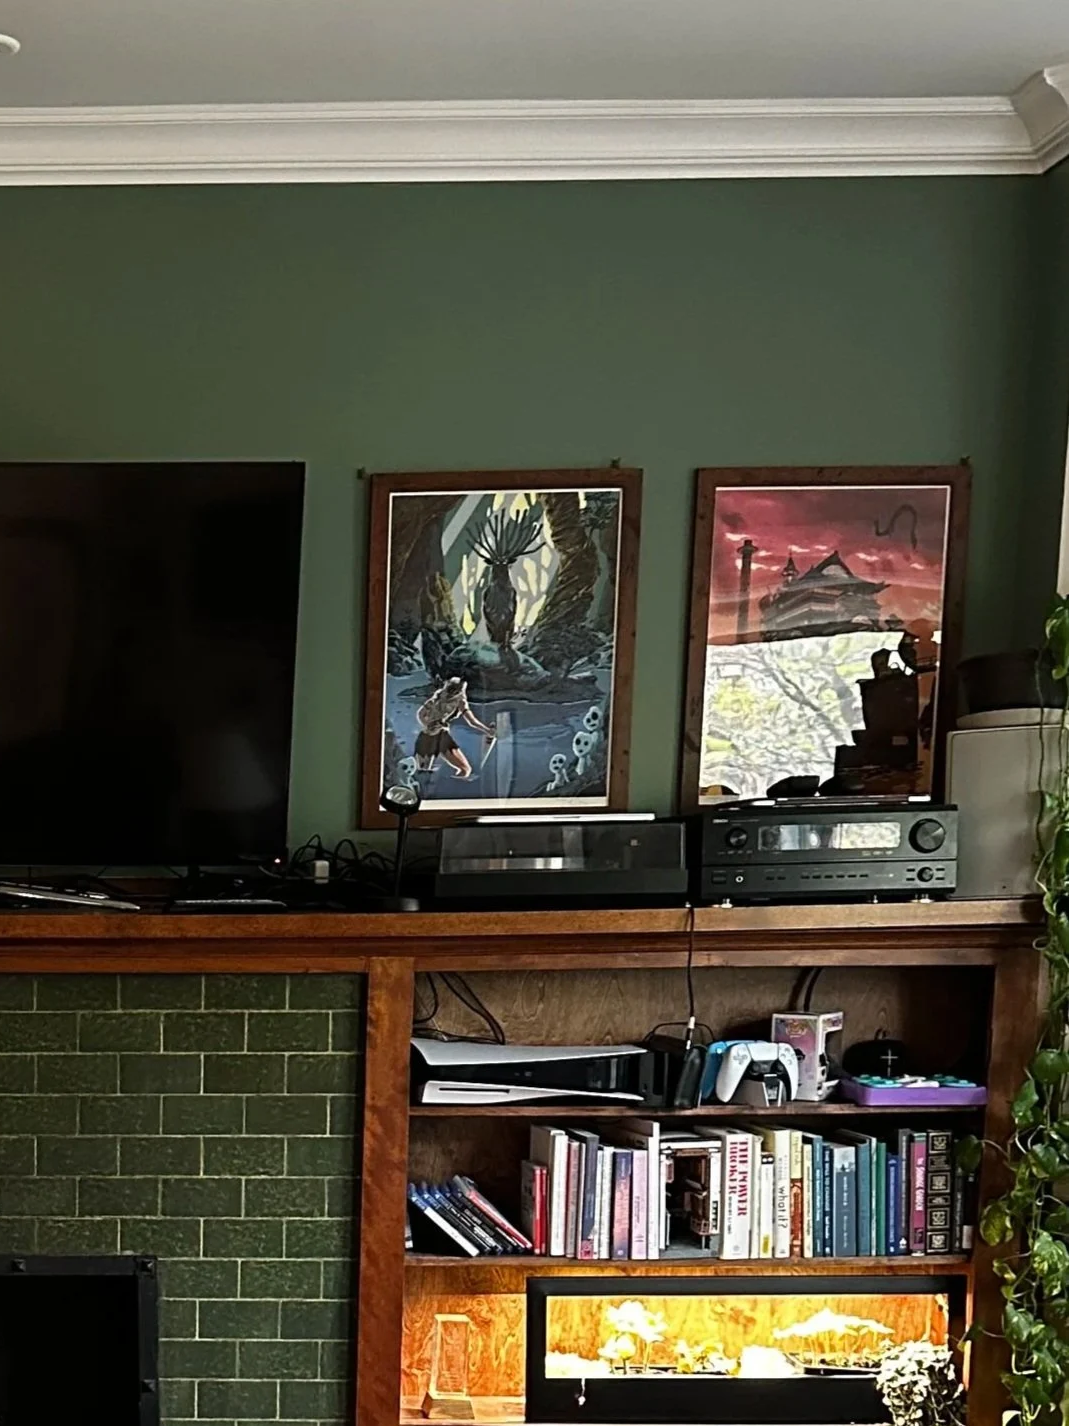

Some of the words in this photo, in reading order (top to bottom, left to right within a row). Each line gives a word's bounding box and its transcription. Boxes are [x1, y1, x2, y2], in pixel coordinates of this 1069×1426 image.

[739, 1141, 749, 1165] THE
[728, 1142, 737, 1195] BROKER
[737, 1171, 748, 1217] POWER
[777, 1186, 789, 1212] what
[777, 1214, 788, 1229] if?
